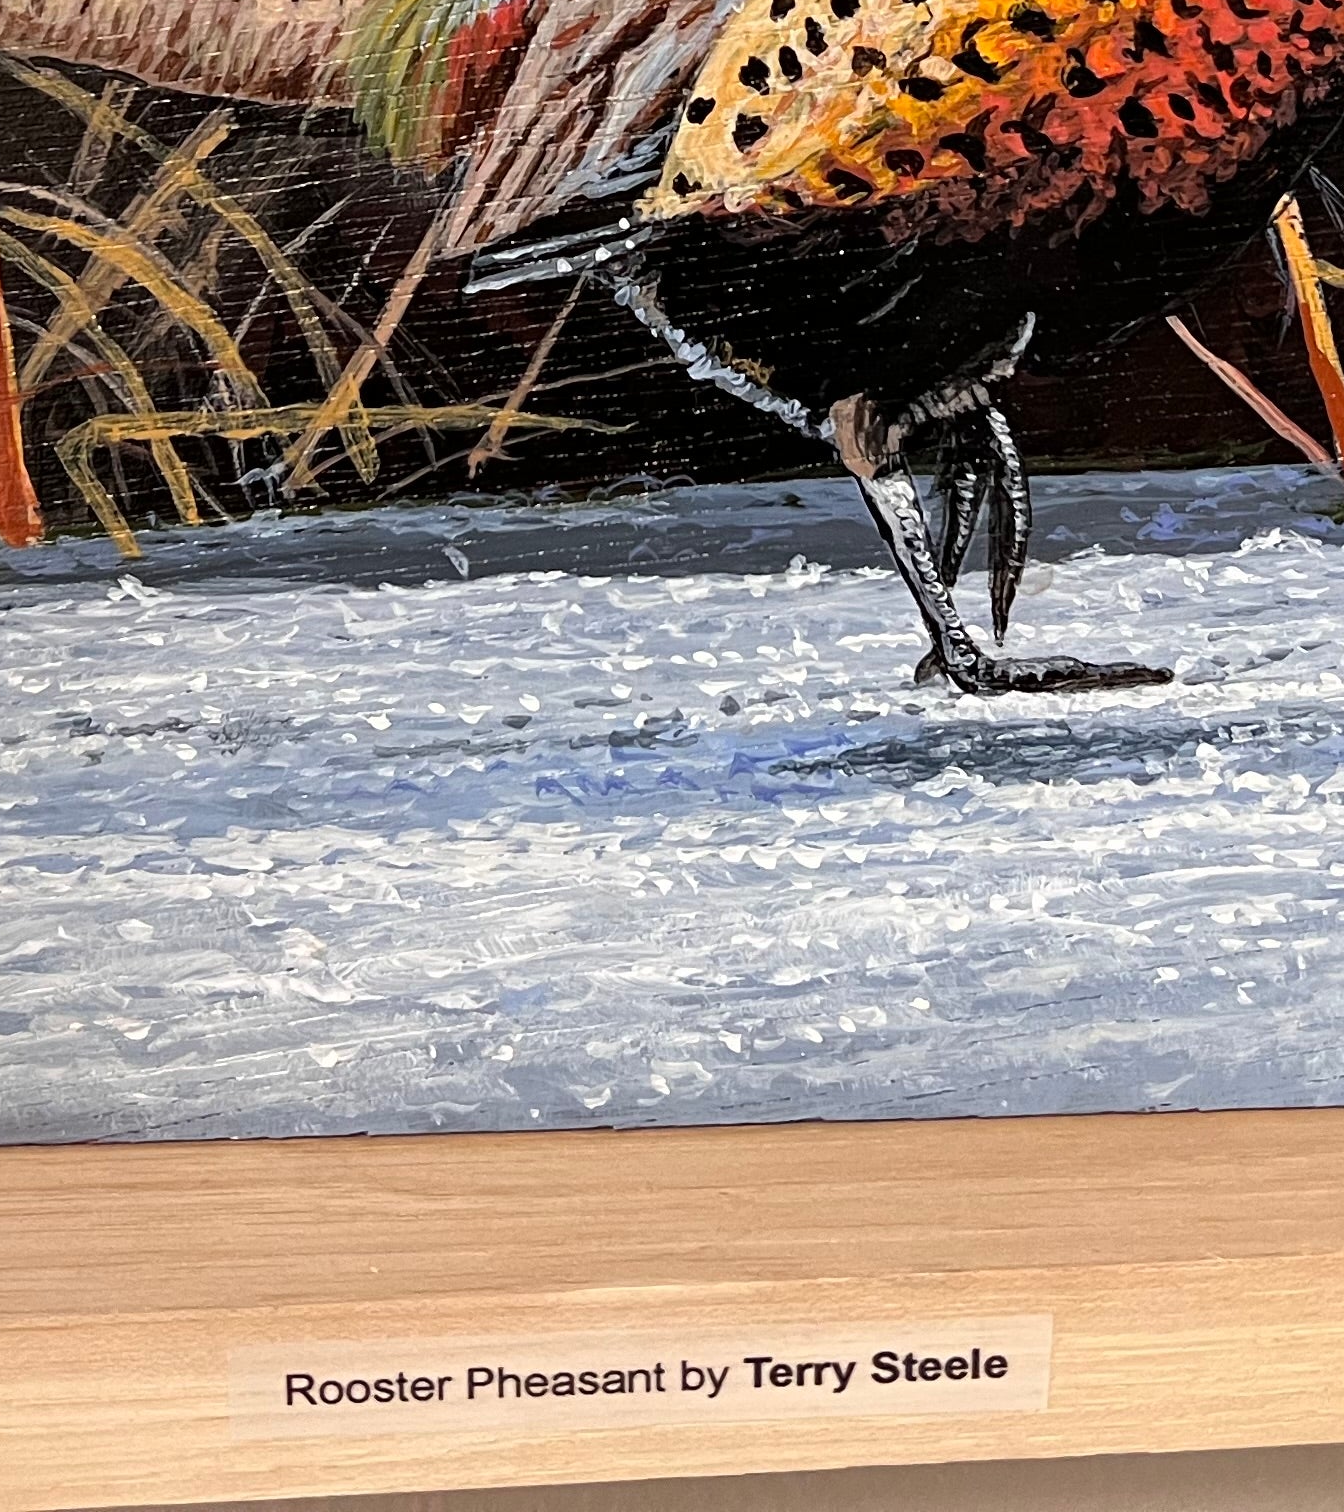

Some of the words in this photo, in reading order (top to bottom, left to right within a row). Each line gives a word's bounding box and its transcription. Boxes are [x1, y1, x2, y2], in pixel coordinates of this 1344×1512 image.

[285, 1371, 453, 1406] Rooster
[467, 1362, 666, 1400] Pheasant
[681, 1360, 730, 1399] by
[743, 1356, 857, 1393] Terry
[871, 1348, 1009, 1384] Steele
